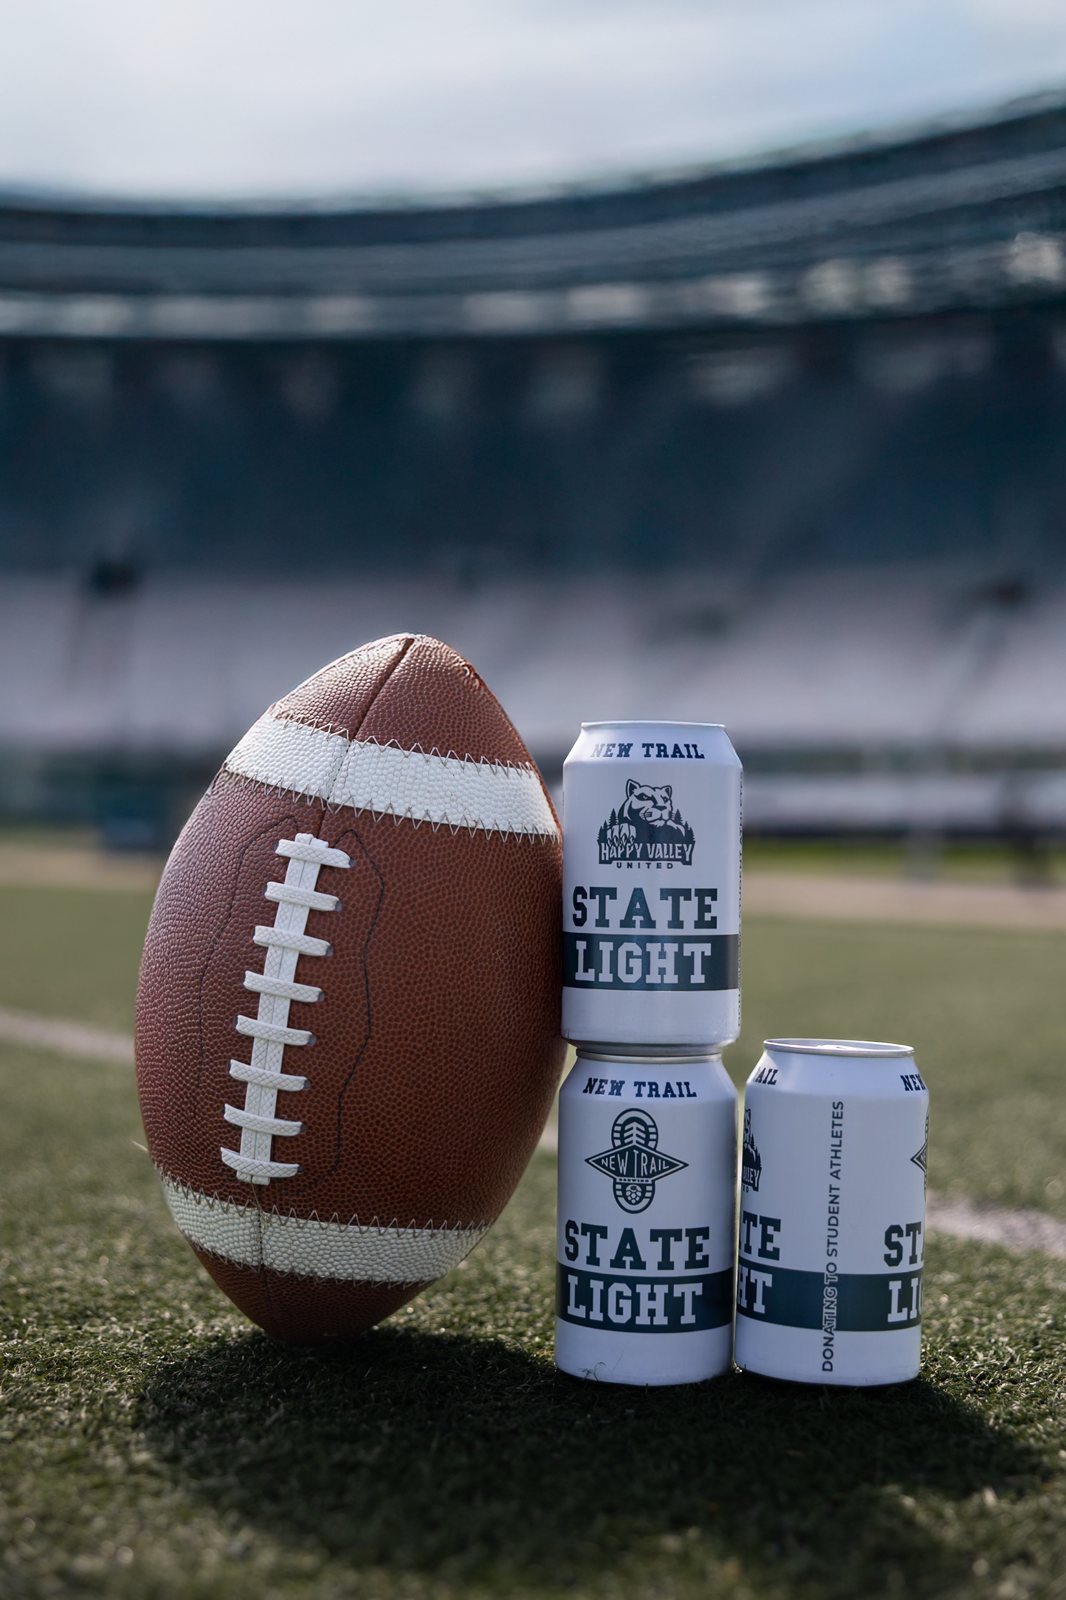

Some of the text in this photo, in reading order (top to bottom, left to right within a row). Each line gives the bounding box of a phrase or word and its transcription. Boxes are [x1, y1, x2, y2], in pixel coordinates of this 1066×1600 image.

[590, 743, 705, 759] NEW TRAIL
[601, 843, 692, 861] HAPPY VALLEY
[572, 886, 718, 929] STATE
[575, 940, 712, 984] LIGHT
[582, 1077, 697, 1098] NEW TRAIL
[753, 1066, 778, 1085] AIL
[601, 1149, 669, 1178] NEW TRAIL
[565, 1219, 710, 1270] STATE
[739, 1210, 781, 1261] TE
[822, 1101, 844, 1372] DONATING TO STUDENT ATHLETES
[883, 1222, 923, 1267] ST
[567, 1274, 703, 1325] LIGHT
[887, 1278, 922, 1323] LI
